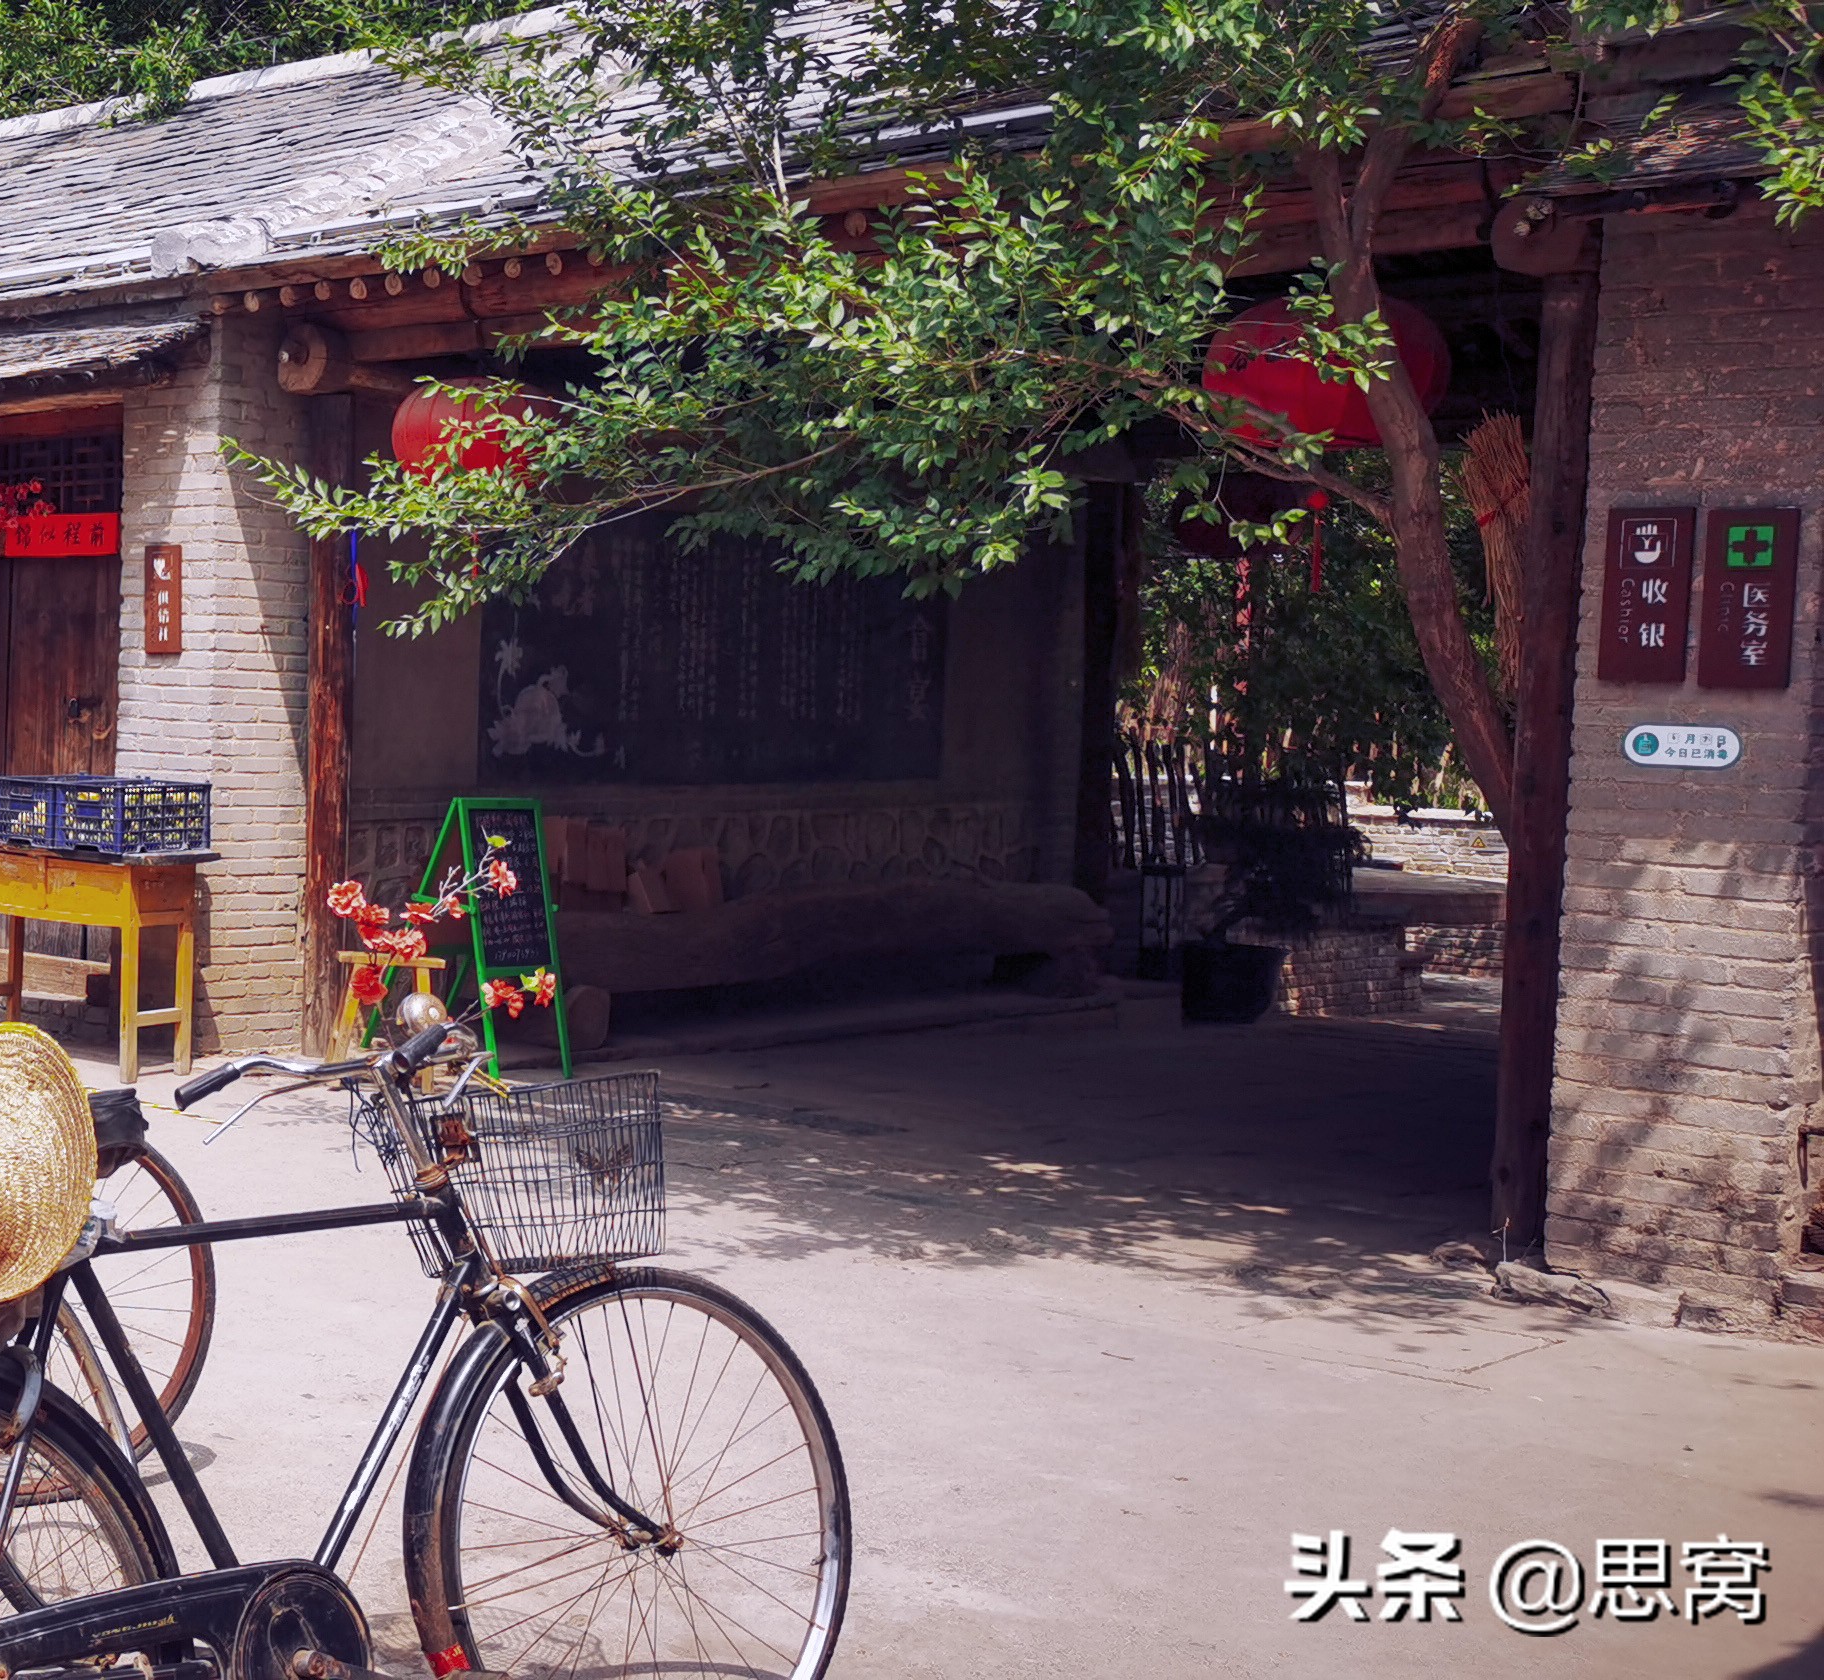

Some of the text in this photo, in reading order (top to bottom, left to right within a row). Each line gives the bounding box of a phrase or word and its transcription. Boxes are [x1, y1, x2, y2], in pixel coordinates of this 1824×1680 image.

[1618, 578, 1636, 643] Cashier
[1638, 577, 1670, 648] 收银
[1740, 582, 1771, 666] 医务室
[1664, 746, 1728, 760] 今日已消毒
